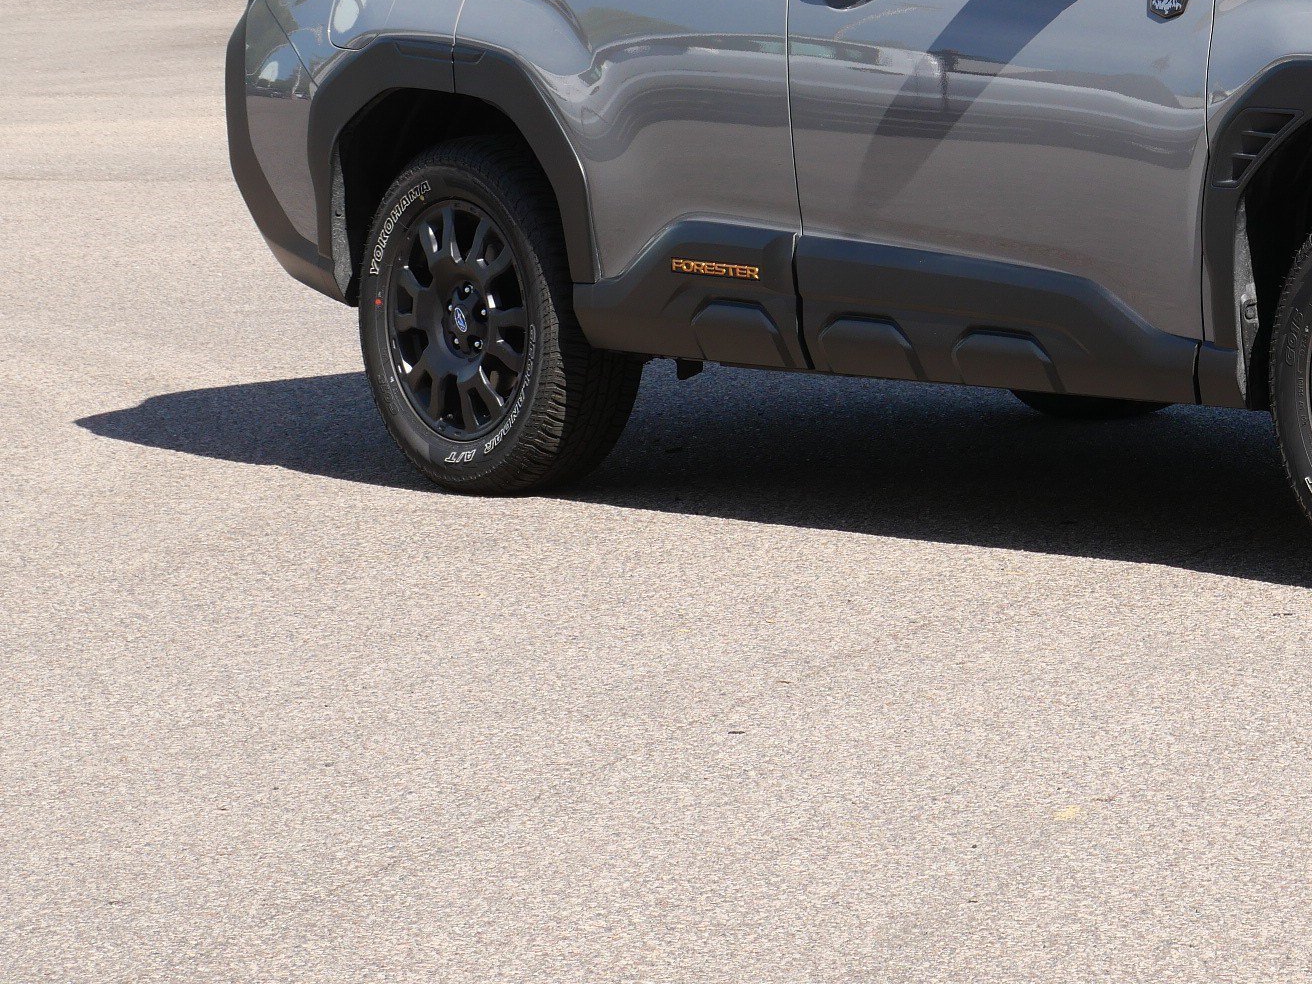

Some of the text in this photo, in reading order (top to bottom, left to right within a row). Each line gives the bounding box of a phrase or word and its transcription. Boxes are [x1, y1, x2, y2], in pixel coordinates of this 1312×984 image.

[369, 180, 431, 276] YOKOHAMA
[671, 259, 759, 280] FORESTER
[445, 447, 477, 464] A/T
